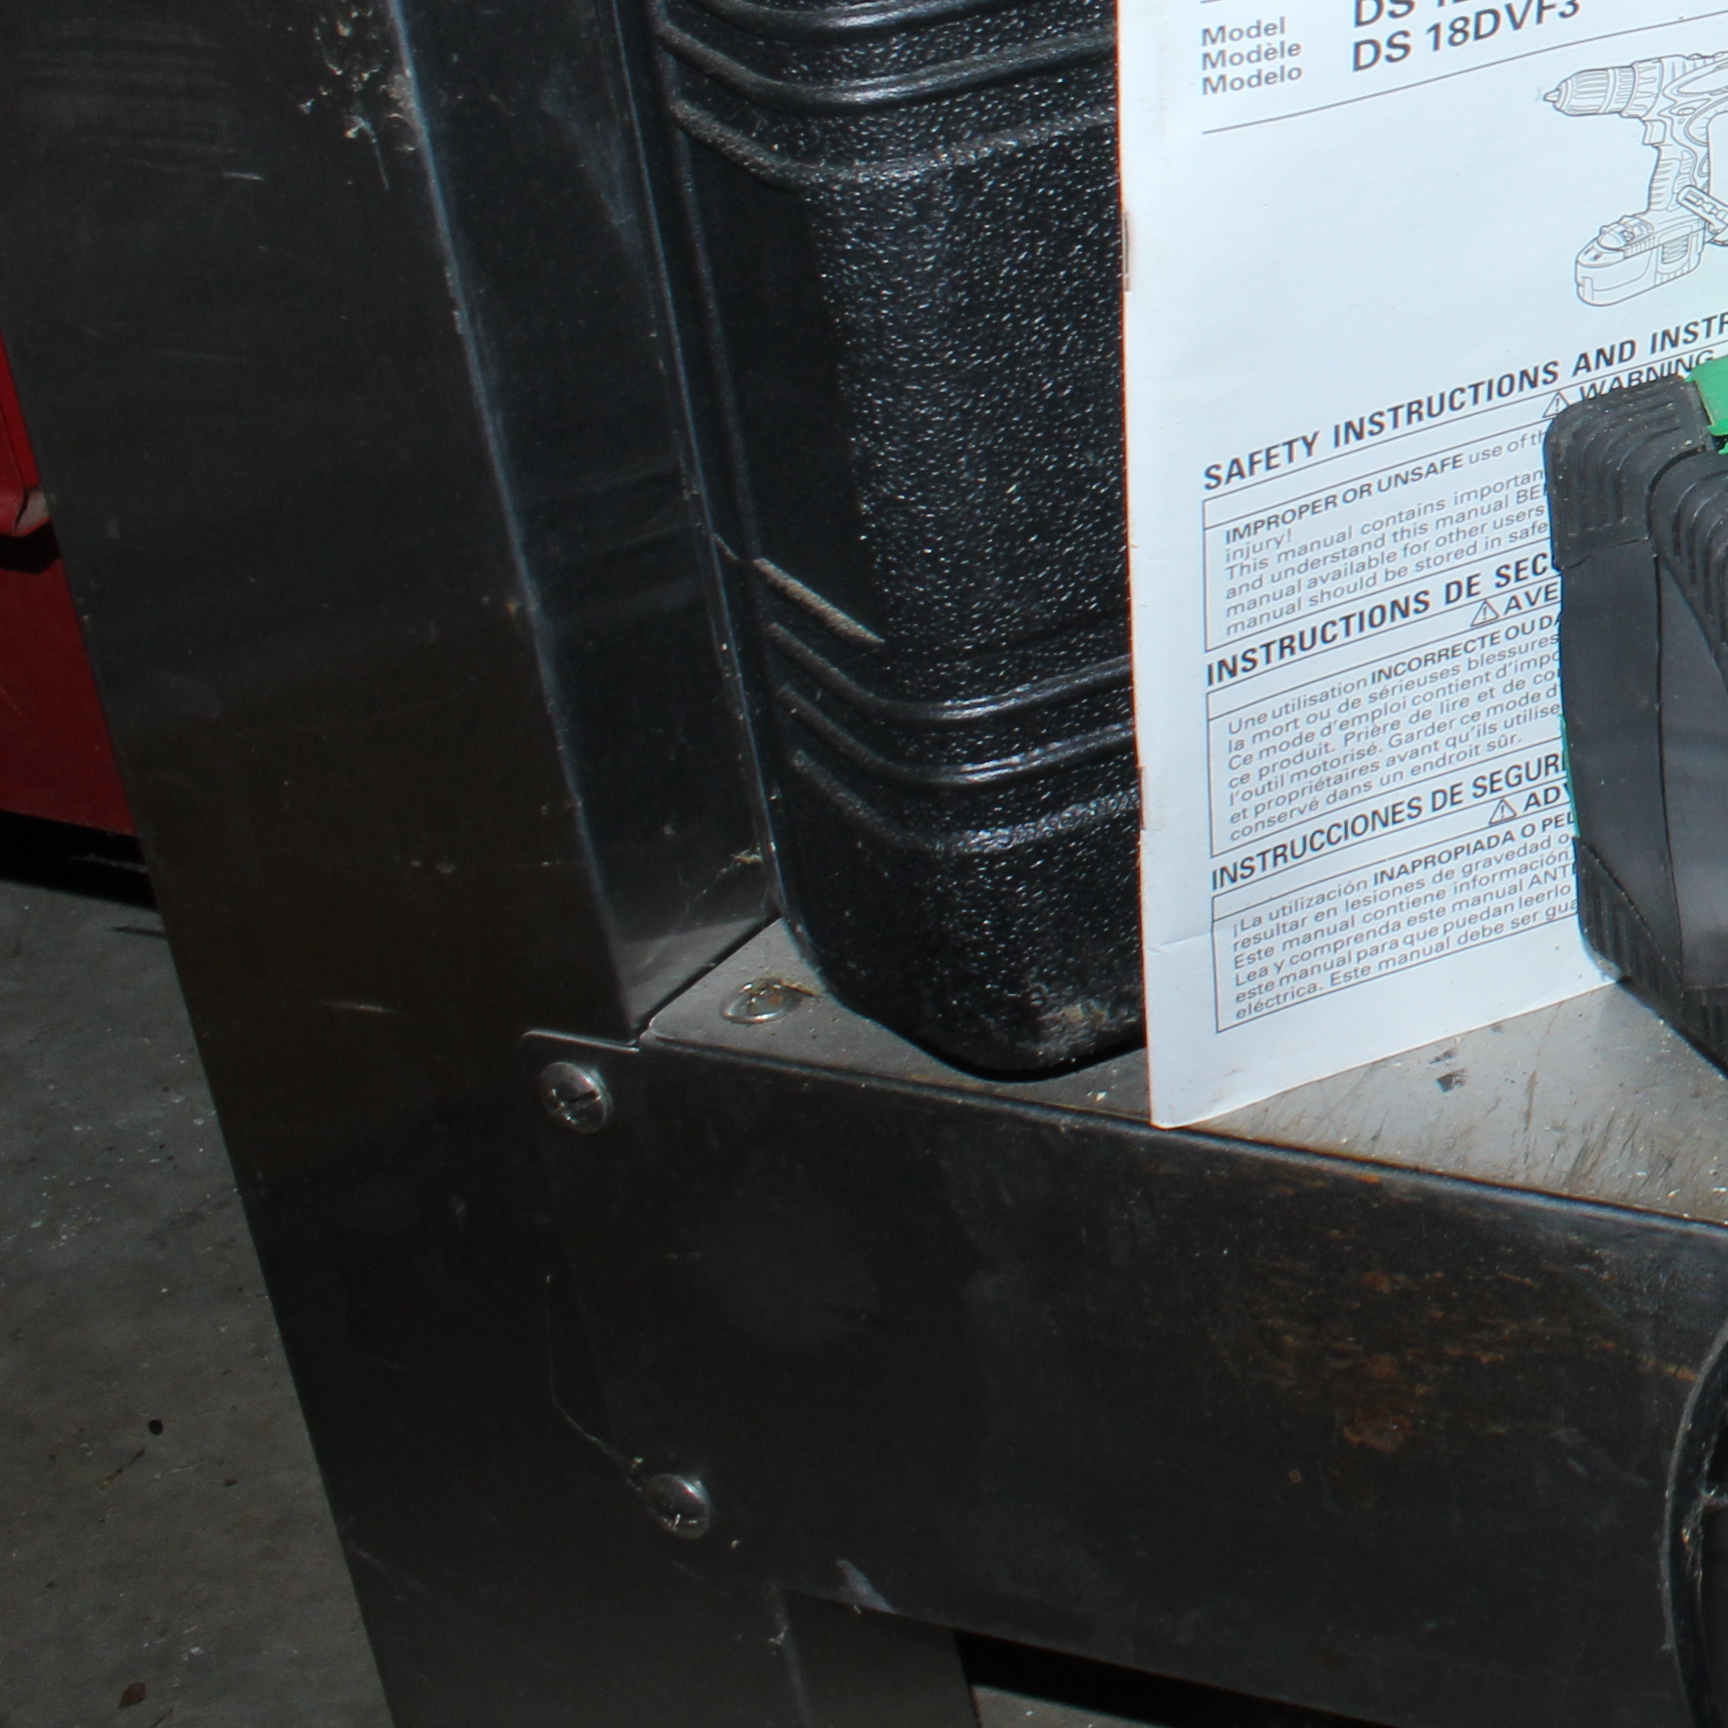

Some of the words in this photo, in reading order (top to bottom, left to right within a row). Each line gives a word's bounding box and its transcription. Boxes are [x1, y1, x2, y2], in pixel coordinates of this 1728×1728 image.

[1201, 15, 1287, 48] Model
[1201, 40, 1302, 71] Modèle
[1201, 64, 1303, 96] Modelo
[1352, 29, 1412, 73] DS
[1203, 430, 1321, 491] SAFETY
[1333, 360, 1560, 450] INSTRUCTIONS
[1571, 339, 1637, 378] AND
[1225, 494, 1337, 543] IMPROPER
[1341, 482, 1372, 503] OR
[1377, 453, 1463, 492] UNSAFE
[1468, 445, 1502, 464] use
[1506, 433, 1526, 452] of
[1225, 557, 1268, 579] This
[1277, 526, 1351, 562] manual
[1360, 499, 1445, 534] contains
[1225, 574, 1262, 599] and
[1270, 533, 1385, 582] understand
[1391, 522, 1428, 542] this
[1435, 494, 1508, 529] manual
[1226, 528, 1290, 562] injury!
[1226, 579, 1301, 616] manual
[1307, 551, 1396, 588] available
[1402, 540, 1430, 557] for
[1435, 522, 1487, 547] other
[1492, 505, 1543, 529] users
[1226, 597, 1301, 635] manual
[1308, 572, 1376, 606] should
[1384, 566, 1407, 582] be
[1415, 540, 1477, 572] stored
[1484, 536, 1501, 550] in
[1508, 520, 1547, 542] safe
[1207, 590, 1429, 684] INSTRUCTIONS
[1444, 572, 1481, 605] DE
[1494, 547, 1549, 588] SEC
[1503, 581, 1557, 615] AVE
[1228, 712, 1267, 734] Une
[1271, 678, 1367, 718] utilisation
[1371, 630, 1500, 684] INCORRECTE
[1504, 619, 1535, 640] OU
[1228, 739, 1244, 753] la
[1252, 717, 1298, 743] mort
[1305, 708, 1330, 724] ou
[1337, 697, 1361, 713] de
[1368, 665, 1460, 703] sérieuses
[1228, 753, 1253, 770] Ce
[1258, 731, 1314, 759] mode
[1411, 671, 1490, 705] contient
[1228, 773, 1250, 788] ce
[1258, 742, 1334, 780] produit.
[1344, 719, 1400, 746] Prière
[1408, 709, 1431, 724] de
[1440, 697, 1469, 714] lire
[1477, 687, 1494, 702] et
[1502, 679, 1525, 694] de
[1230, 807, 1247, 823] et
[1254, 761, 1379, 817] propriétaires
[1385, 740, 1438, 766] avant
[1290, 742, 1381, 782] motorisé.
[1388, 718, 1455, 747] Garder
[1459, 710, 1481, 725] ce
[1486, 691, 1540, 717] mode
[1212, 796, 1422, 889] INSTRUCCIONES
[1430, 781, 1463, 812] DE
[1230, 796, 1318, 840] conservé
[1325, 780, 1372, 804] dans
[1379, 770, 1403, 786] un
[1410, 744, 1479, 775] endroit
[1486, 733, 1521, 751] sûr.
[1233, 916, 1307, 951] resultar
[1314, 906, 1337, 922] en
[1345, 878, 1424, 911] lesiones
[1431, 868, 1454, 884] de
[1461, 835, 1551, 877] gravedad
[1268, 880, 1367, 920] utilización
[1373, 830, 1515, 885] INAPROPIADA
[1520, 823, 1535, 838] O
[1234, 946, 1274, 969] Este
[1282, 914, 1354, 950] manual
[1362, 889, 1445, 923] contiene
[1235, 966, 1268, 986] Lea
[1273, 960, 1282, 974] y
[1289, 920, 1400, 965] comprenda
[1406, 906, 1446, 926] este
[1451, 878, 1522, 912] manual
[1235, 981, 1274, 1002] este
[1279, 950, 1351, 986] manual
[1356, 938, 1398, 963] para
[1402, 926, 1438, 946] que
[1443, 902, 1514, 937] puedan
[1518, 884, 1570, 908] leerlo
[1235, 983, 1322, 1018] eléctrica.
[1330, 962, 1370, 986] Este
[1378, 934, 1449, 970] manual
[1457, 923, 1504, 944] debe
[1510, 911, 1538, 929] ser
